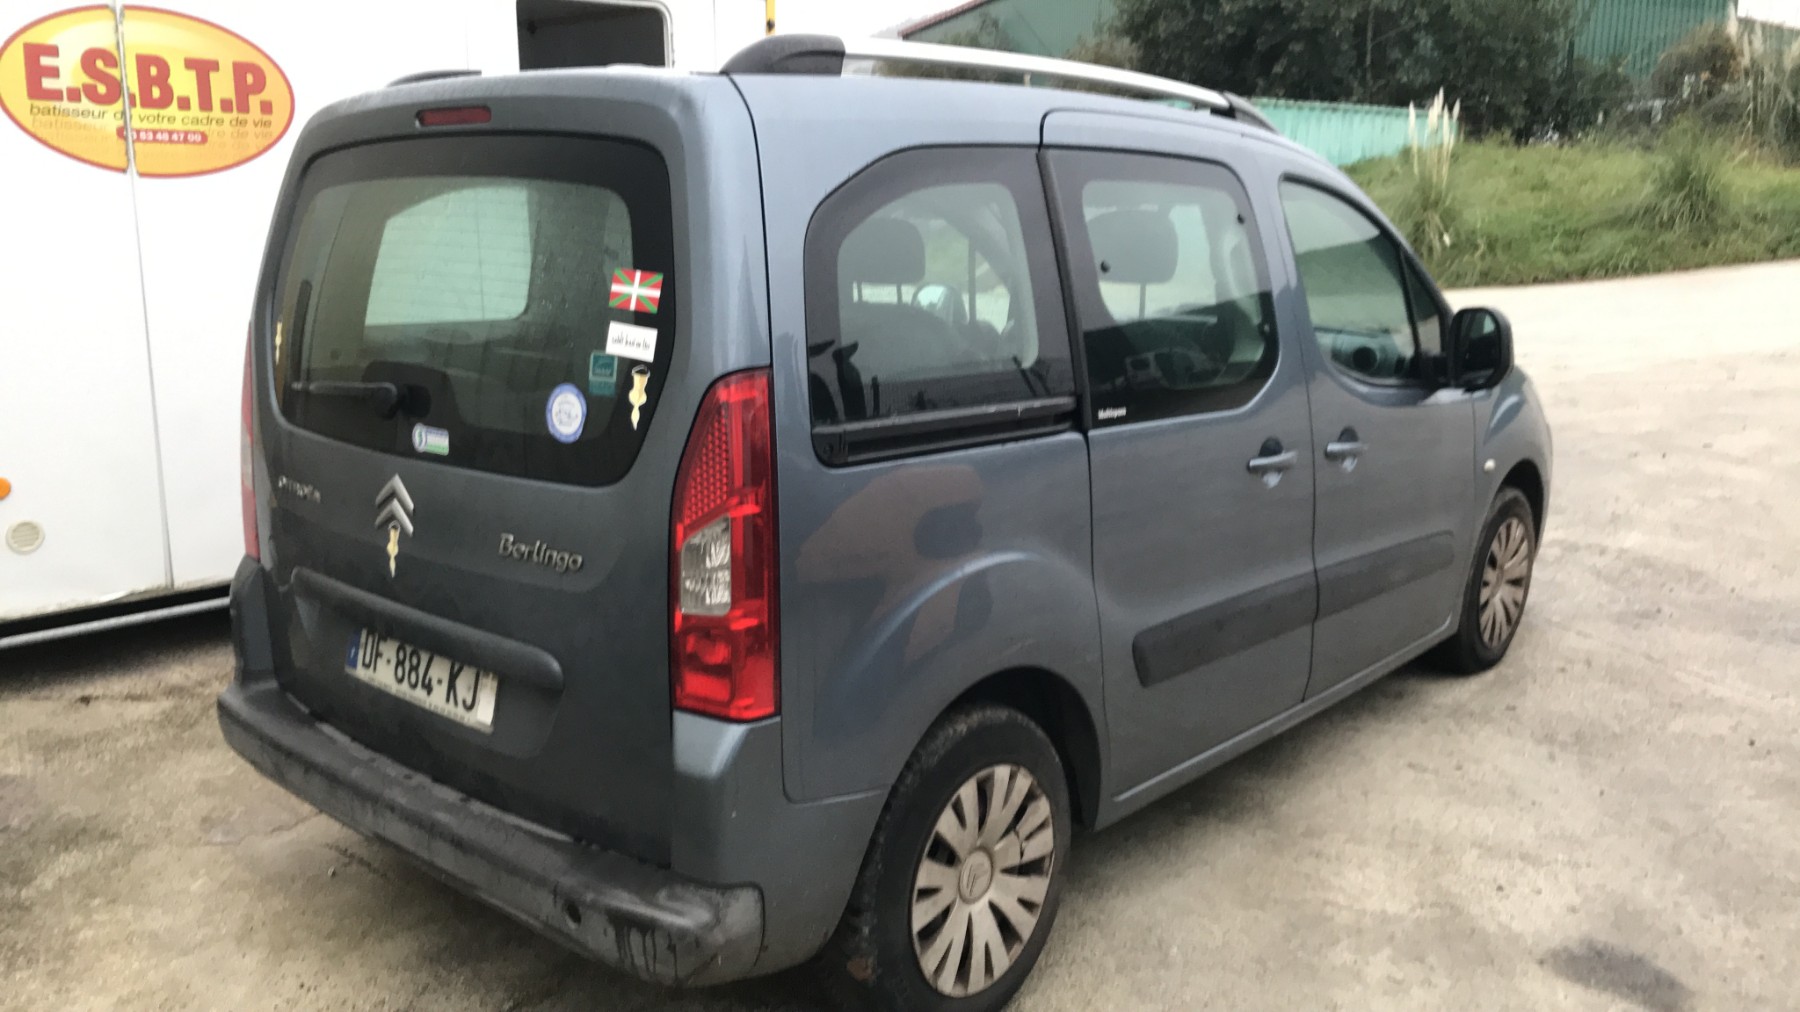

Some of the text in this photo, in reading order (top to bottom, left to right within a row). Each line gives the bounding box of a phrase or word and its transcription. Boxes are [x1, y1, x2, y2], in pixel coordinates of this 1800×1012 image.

[23, 42, 273, 116] E.S.B.T.P.
[29, 103, 109, 119] batisseur
[138, 112, 177, 125] votre
[181, 114, 225, 127] cadre
[229, 116, 249, 128] de
[252, 117, 272, 129] vie
[499, 532, 583, 573] Berlingo
